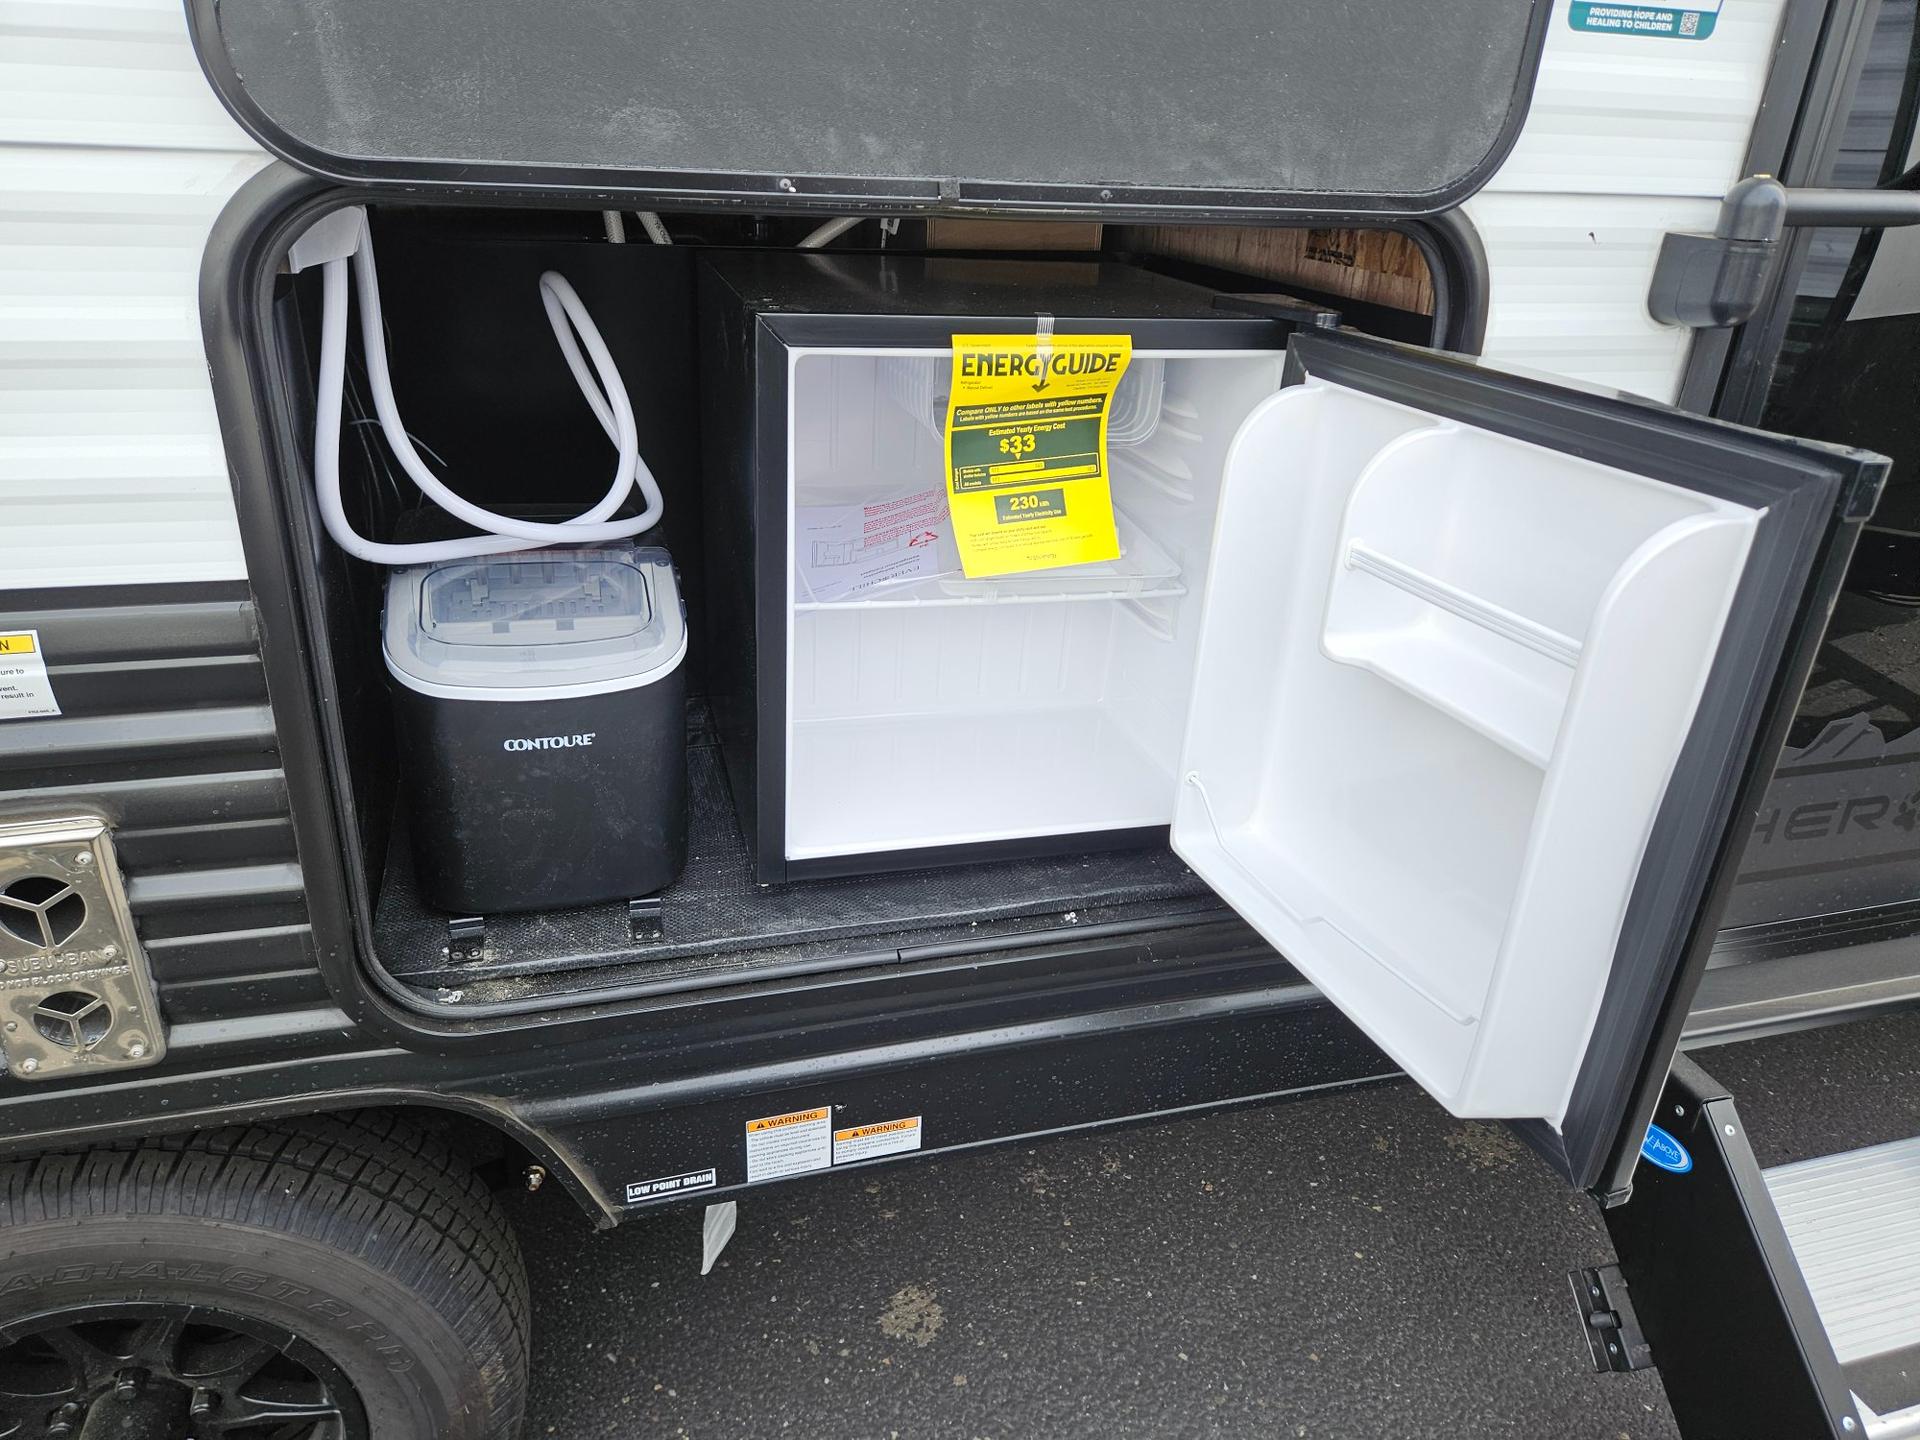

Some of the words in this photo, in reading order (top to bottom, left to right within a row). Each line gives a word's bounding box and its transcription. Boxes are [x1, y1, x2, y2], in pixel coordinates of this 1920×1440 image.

[1589, 7, 1632, 19] PROVIDING
[1634, 10, 1656, 20] HOPE
[1656, 12, 1673, 21] AND
[1586, 17, 1621, 27] HEALING
[1622, 20, 1633, 28] TO
[1634, 21, 1673, 31] CHILDREN
[956, 408, 984, 416] Compare
[1044, 400, 1057, 408] with
[1057, 399, 1077, 408] yellow
[988, 427, 1016, 436] Estimated
[1016, 426, 1033, 435] Yearly
[1033, 424, 1052, 433] Energy
[1052, 422, 1066, 430] Cost
[999, 434, 1036, 454] $33
[1009, 495, 1039, 511] 230
[1, 692, 25, 700] result
[504, 733, 593, 751] CONTOURE
[6, 950, 100, 973] SUBURBAN
[6, 978, 30, 989] NOT
[31, 972, 71, 986] BLOCK
[71, 965, 130, 980] OPENINGS
[767, 1111, 818, 1127] WARNING
[861, 1121, 906, 1136] WARNING
[629, 1185, 650, 1196] LOW
[652, 1179, 681, 1192] POINT
[683, 1172, 712, 1185] DRAIN
